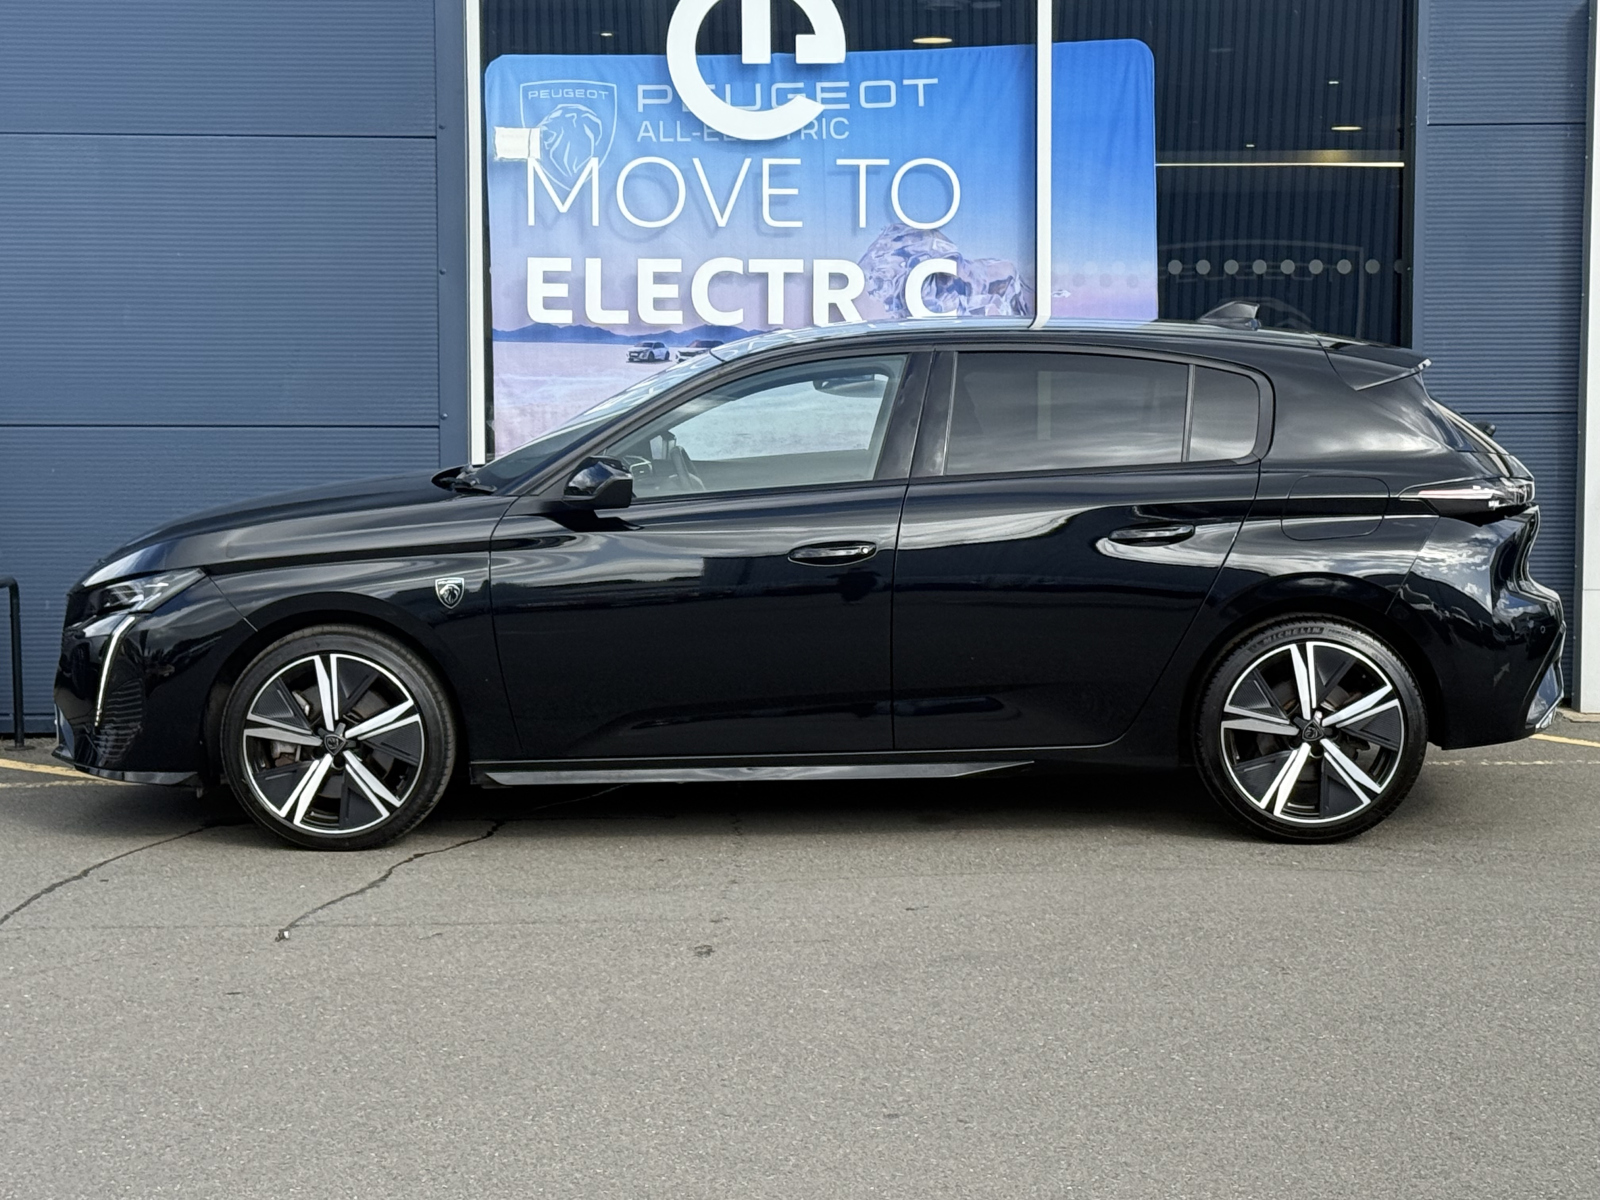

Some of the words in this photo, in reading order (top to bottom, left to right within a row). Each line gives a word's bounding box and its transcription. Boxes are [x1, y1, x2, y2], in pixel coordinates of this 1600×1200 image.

[527, 88, 609, 100] PEUGEOT
[637, 78, 938, 112] PUGEOT
[636, 117, 849, 142] ALL-ERIC
[527, 156, 803, 228] MOVE
[836, 157, 961, 230] TO
